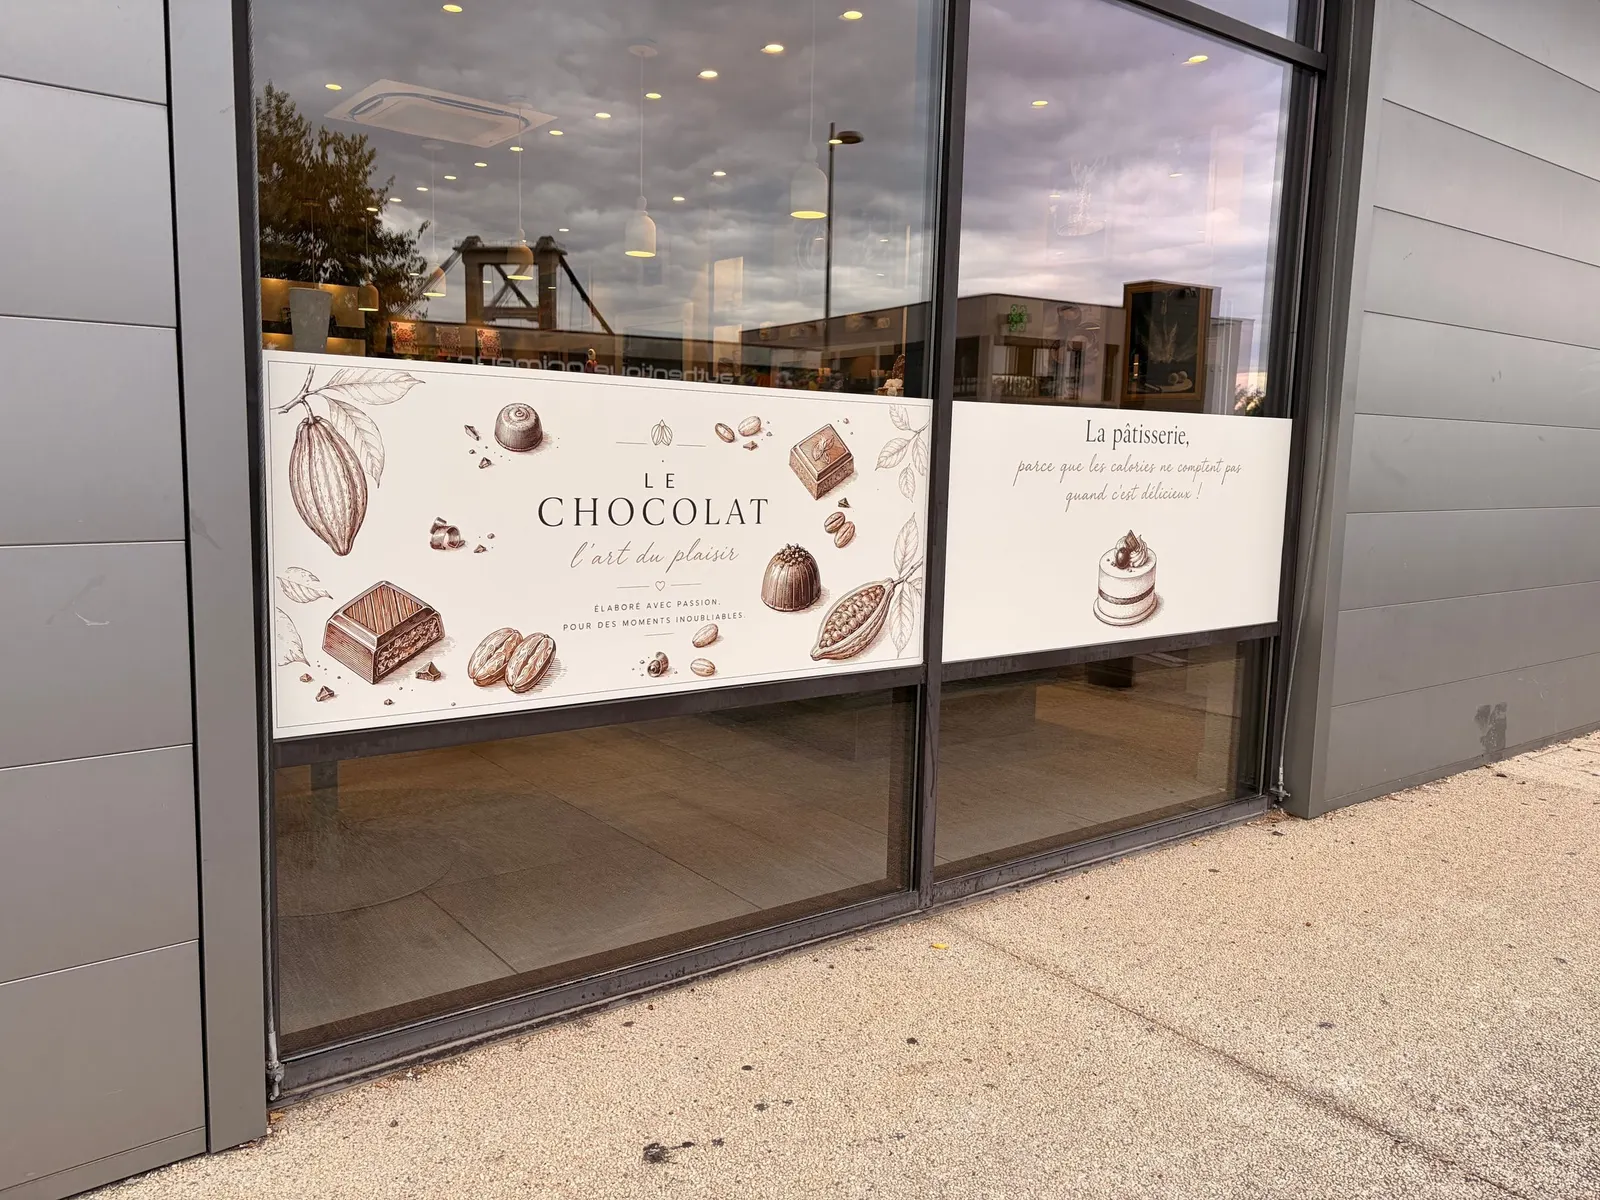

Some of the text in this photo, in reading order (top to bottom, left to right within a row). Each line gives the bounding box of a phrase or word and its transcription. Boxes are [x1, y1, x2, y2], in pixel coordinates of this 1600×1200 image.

[1086, 420, 1189, 450] La pâtisserie,
[645, 473, 675, 488] LE
[1013, 453, 1242, 486] parce que les calories ne comptent pas
[538, 497, 768, 527] CHOCOLAT
[1065, 482, 1203, 512] quand c'est délicieux !
[570, 538, 739, 573] l'art du plaisir
[563, 611, 745, 632] POUR DES MOMENTS INOUBLIABLES.
[594, 602, 640, 613] ÉLABORÉ
[646, 600, 672, 610] AVEC
